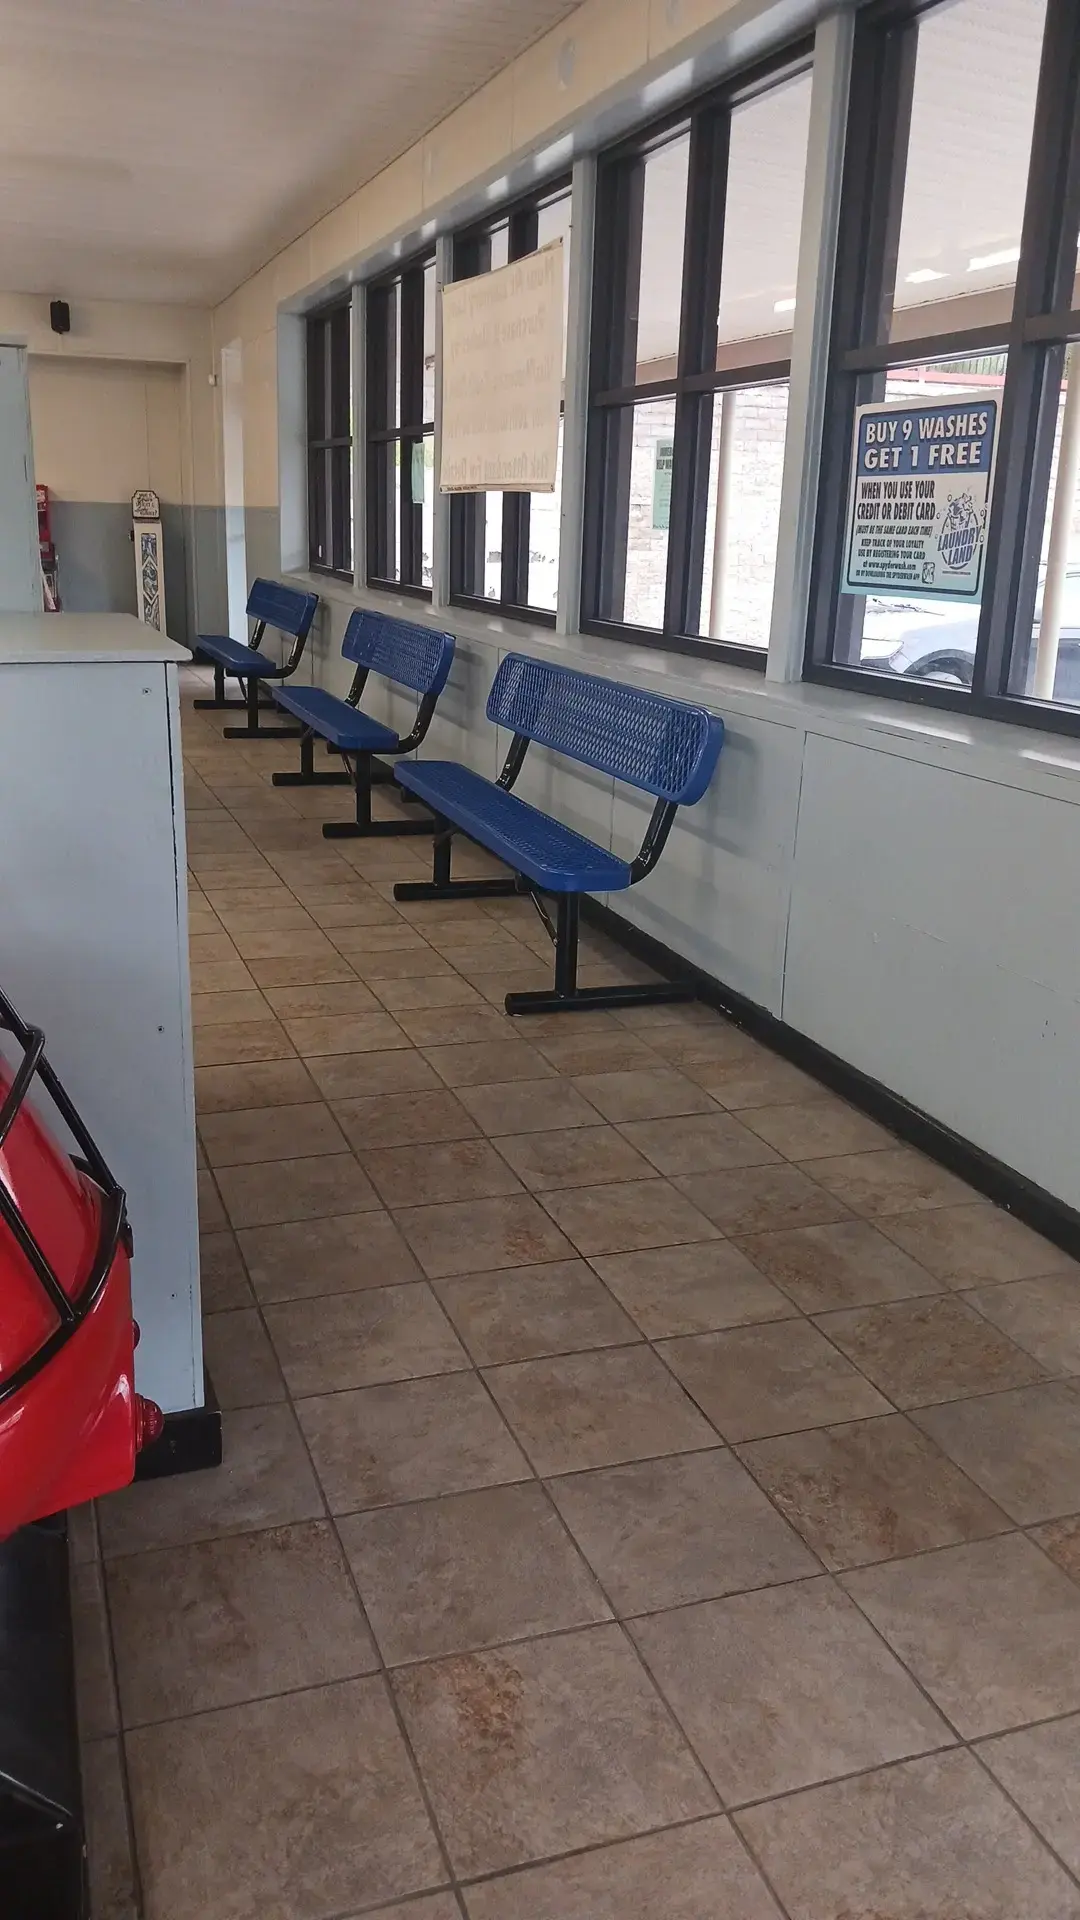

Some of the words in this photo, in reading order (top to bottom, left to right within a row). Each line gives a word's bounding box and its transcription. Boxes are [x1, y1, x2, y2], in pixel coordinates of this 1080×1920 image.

[866, 421, 898, 444] BUY
[902, 420, 913, 440] 9
[919, 412, 987, 439] WASHES
[864, 447, 902, 469] GET
[911, 446, 919, 467] 1
[928, 442, 982, 466] FREE
[861, 482, 882, 499] WHEN
[884, 482, 897, 499] YOU
[899, 482, 913, 498] USE
[915, 481, 935, 498] YOUR
[858, 503, 880, 520] CREDIT
[882, 503, 891, 520] OR
[894, 503, 914, 520] DEBIT
[916, 503, 935, 520] CARD
[856, 525, 869, 535] (MUST
[870, 525, 875, 534] BE
[875, 525, 883, 534] THE
[884, 526, 895, 534] SAME
[896, 526, 908, 535] CARD
[908, 526, 919, 535] EACH
[937, 525, 982, 551] LAUNDRY
[861, 539, 871, 547] KEEP
[872, 539, 885, 547] TRACK
[887, 539, 892, 547] OF
[893, 540, 905, 548] YOUR
[906, 540, 924, 548] LOYALTY
[873, 550, 899, 558] REGISTERING
[901, 551, 912, 559] YOUR
[914, 551, 925, 560] CARD
[948, 544, 973, 565] LAND
